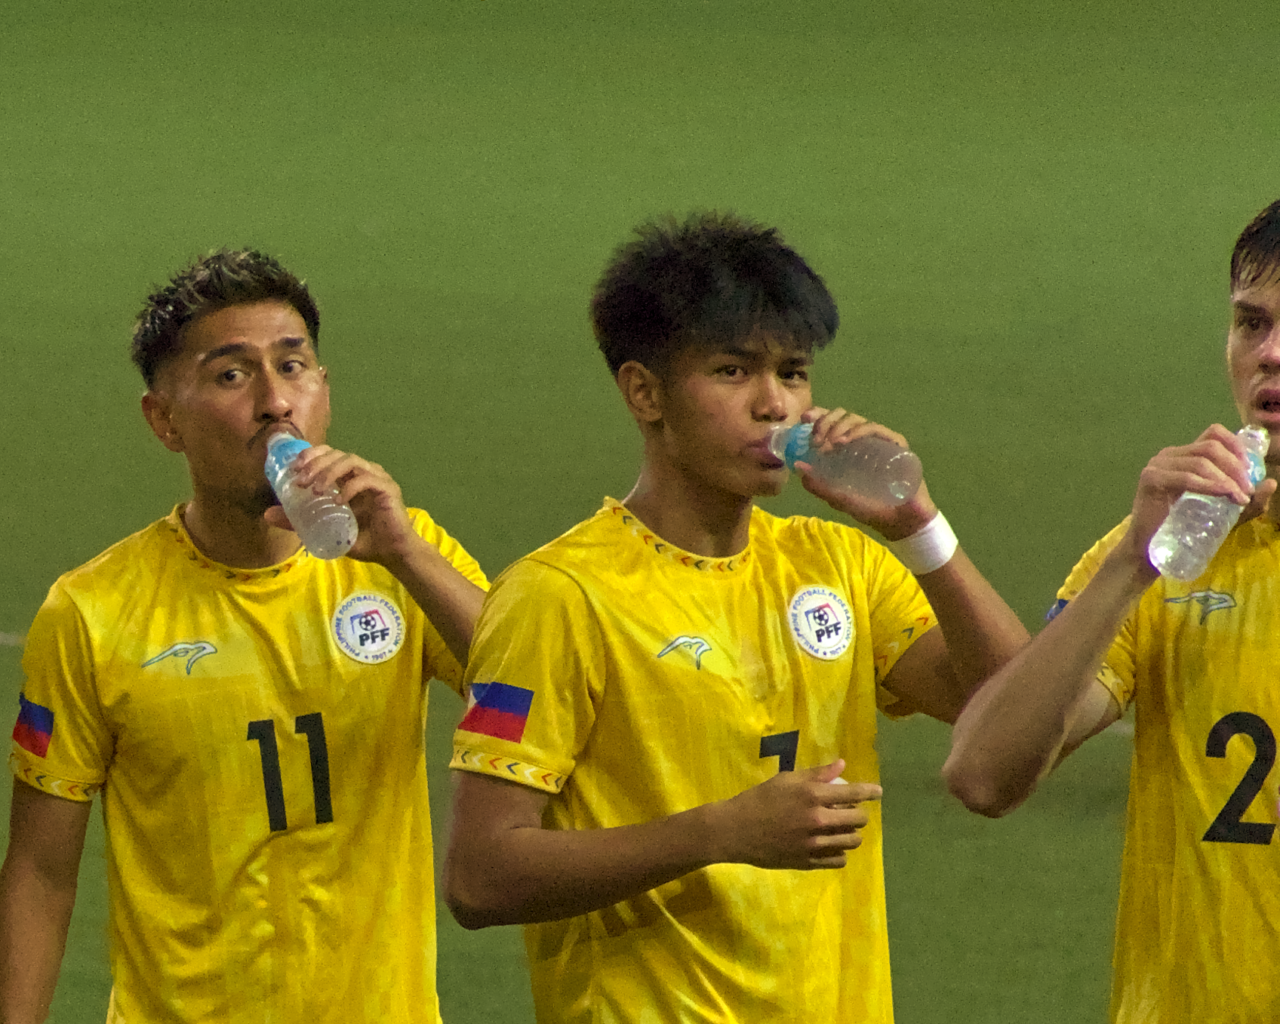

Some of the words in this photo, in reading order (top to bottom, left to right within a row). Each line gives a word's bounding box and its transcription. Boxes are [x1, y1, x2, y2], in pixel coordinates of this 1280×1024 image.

[339, 595, 379, 615] FOOTBALL
[793, 589, 826, 610] FOOTBALL
[359, 627, 390, 647] PFF
[815, 621, 842, 643] PFF
[247, 712, 333, 832] 11
[1202, 711, 1276, 845] 2
